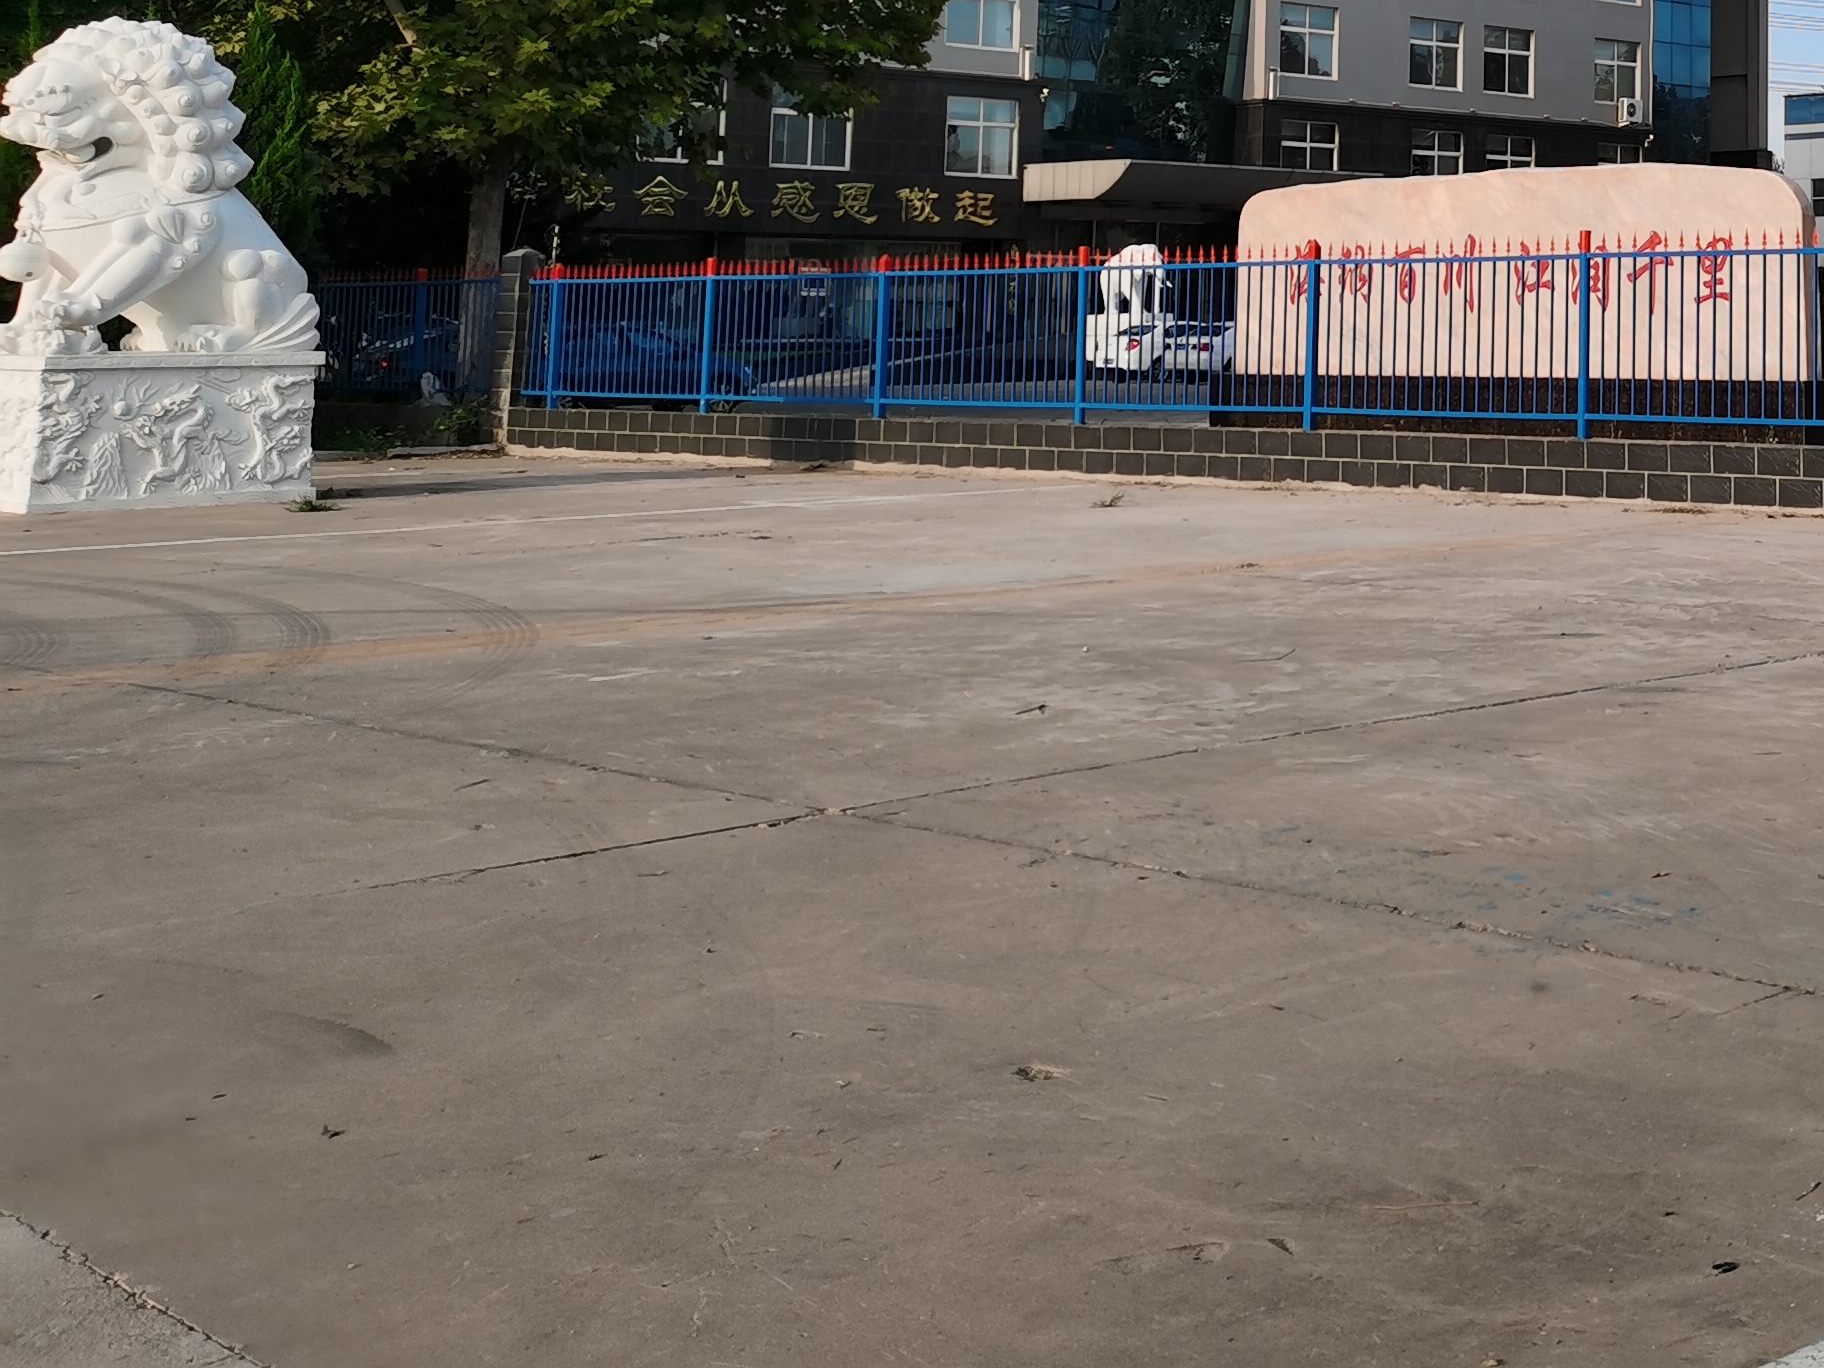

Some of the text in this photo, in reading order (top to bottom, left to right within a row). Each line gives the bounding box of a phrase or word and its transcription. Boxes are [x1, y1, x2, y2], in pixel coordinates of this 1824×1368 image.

[565, 174, 999, 226] 社会从感恩做起
